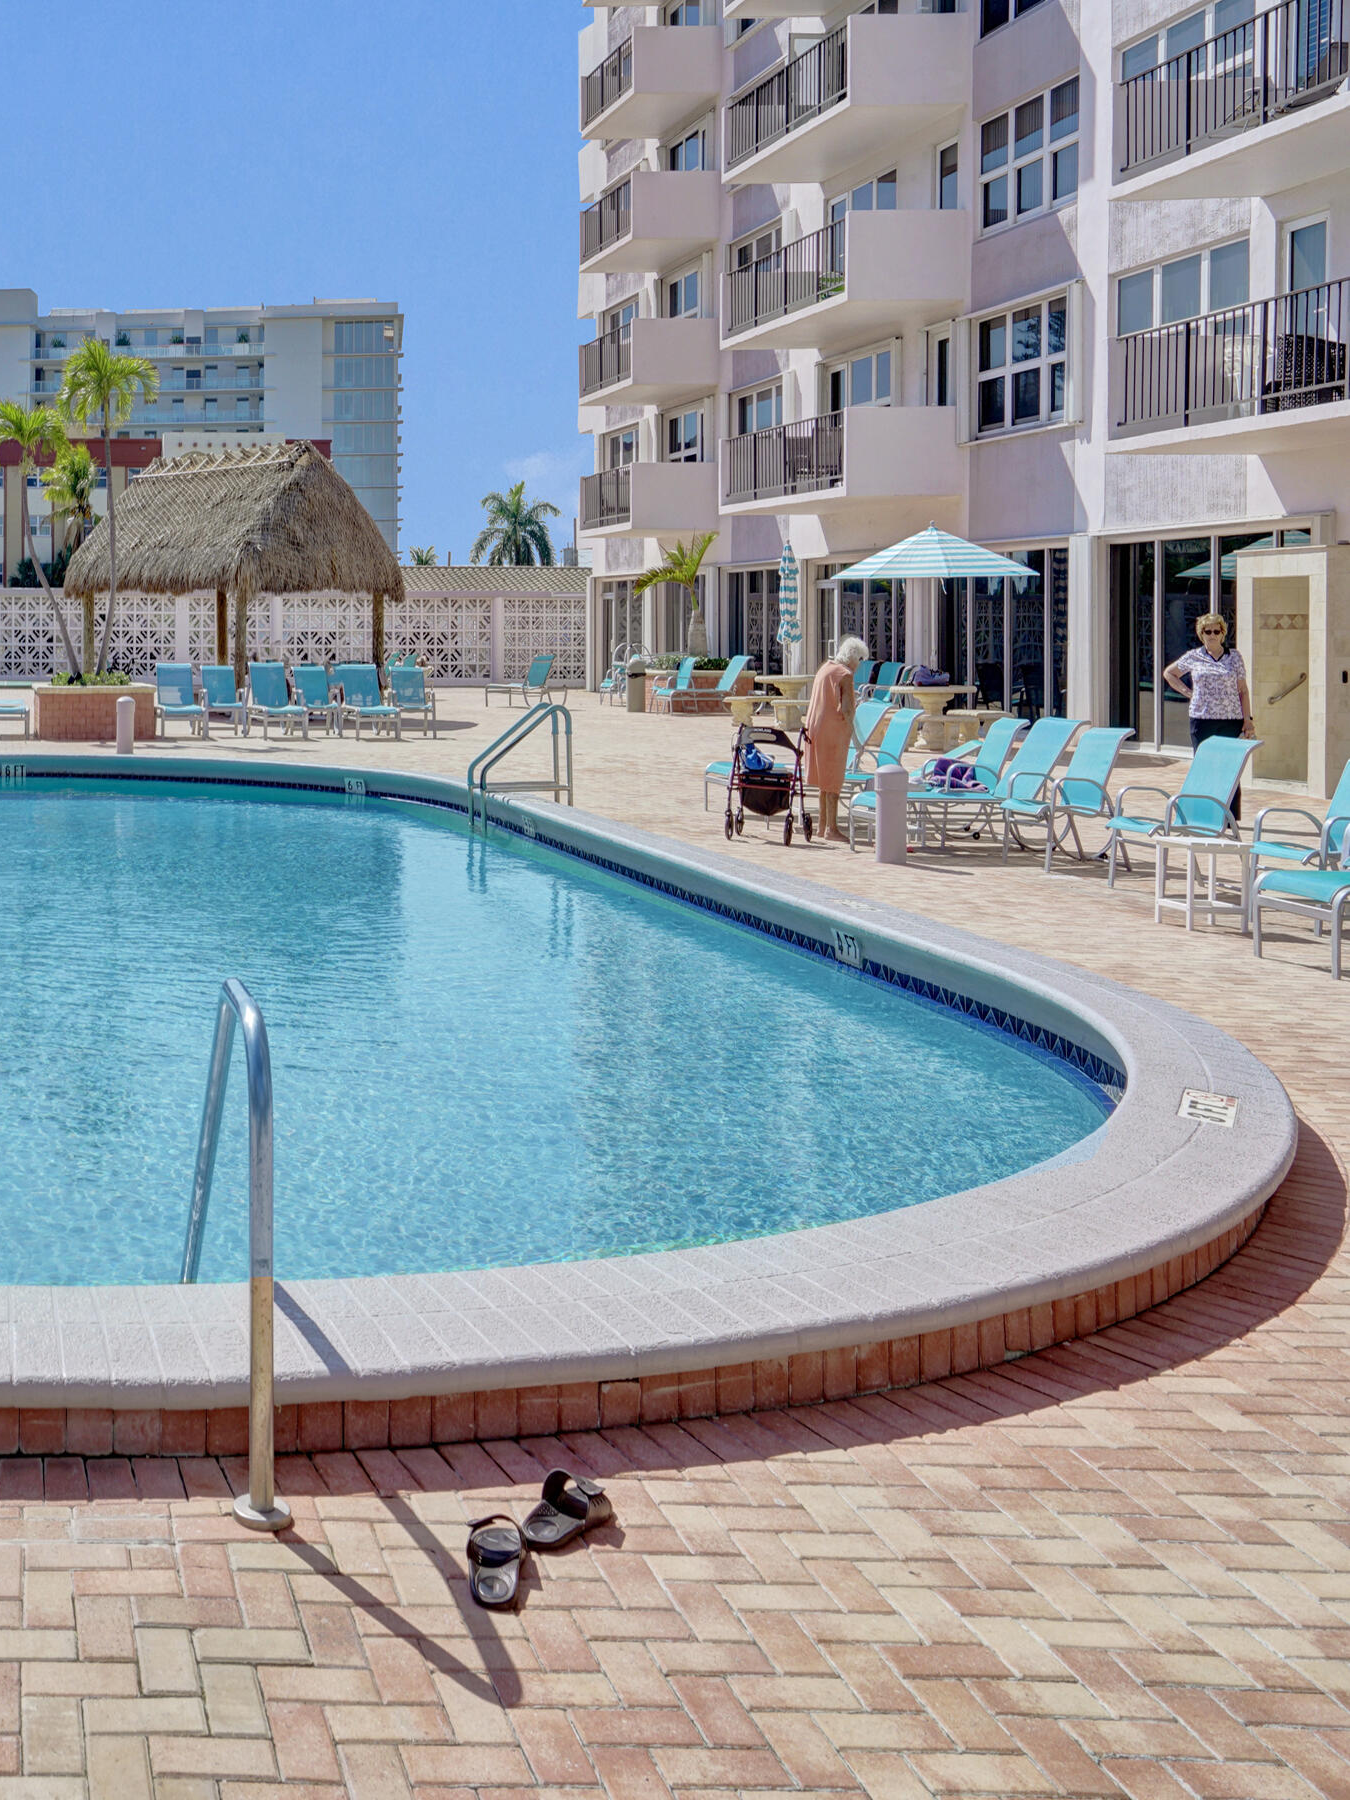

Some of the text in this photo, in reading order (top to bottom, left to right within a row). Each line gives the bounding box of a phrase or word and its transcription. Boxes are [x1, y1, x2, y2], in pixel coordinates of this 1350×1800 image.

[5, 765, 25, 776] 6 FT
[355, 780, 363, 791] FT
[843, 934, 857, 959] FT
[1188, 1100, 1229, 1116] FT
